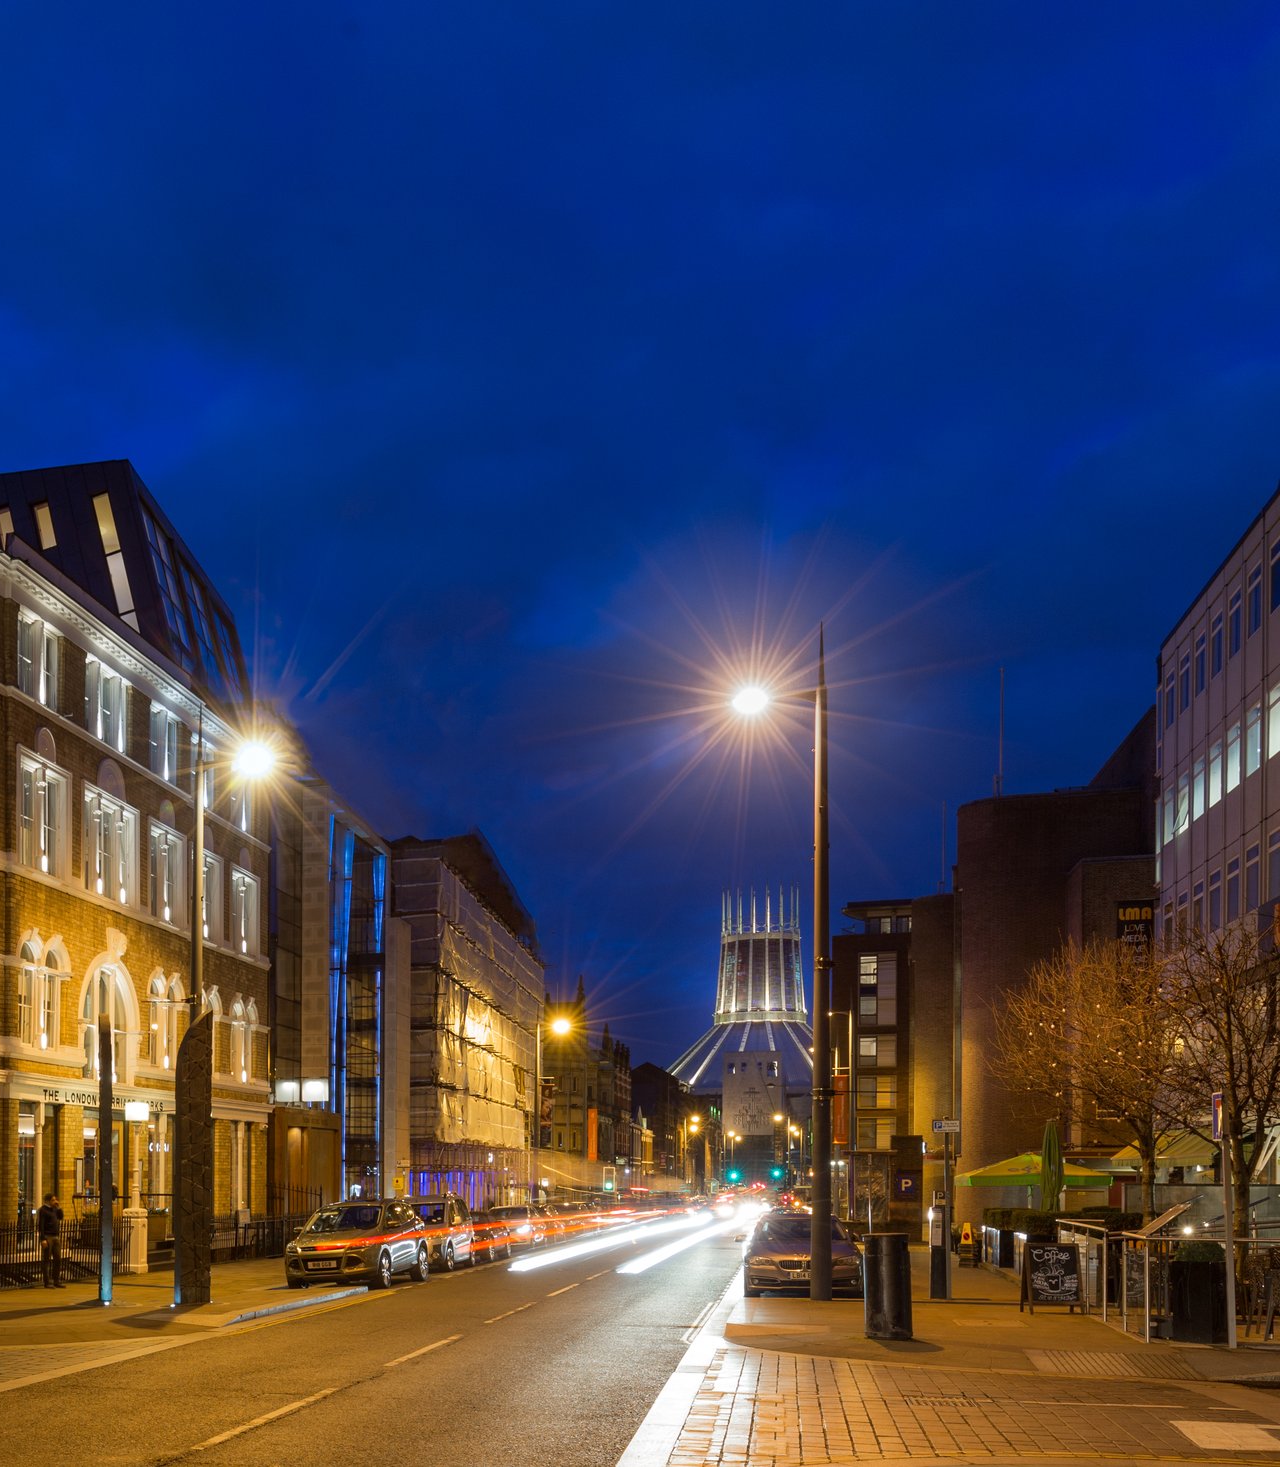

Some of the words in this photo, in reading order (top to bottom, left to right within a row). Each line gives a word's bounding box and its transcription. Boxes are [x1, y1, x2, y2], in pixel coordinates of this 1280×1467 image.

[1118, 907, 1152, 921] LMA
[1124, 923, 1146, 932] LOVE
[1121, 934, 1148, 943] MEDIA
[43, 1089, 59, 1102] THE
[65, 1091, 97, 1106] LONDON
[901, 1178, 913, 1192] P
[937, 1191, 944, 1200] P
[1030, 1248, 1071, 1264] Coffee
